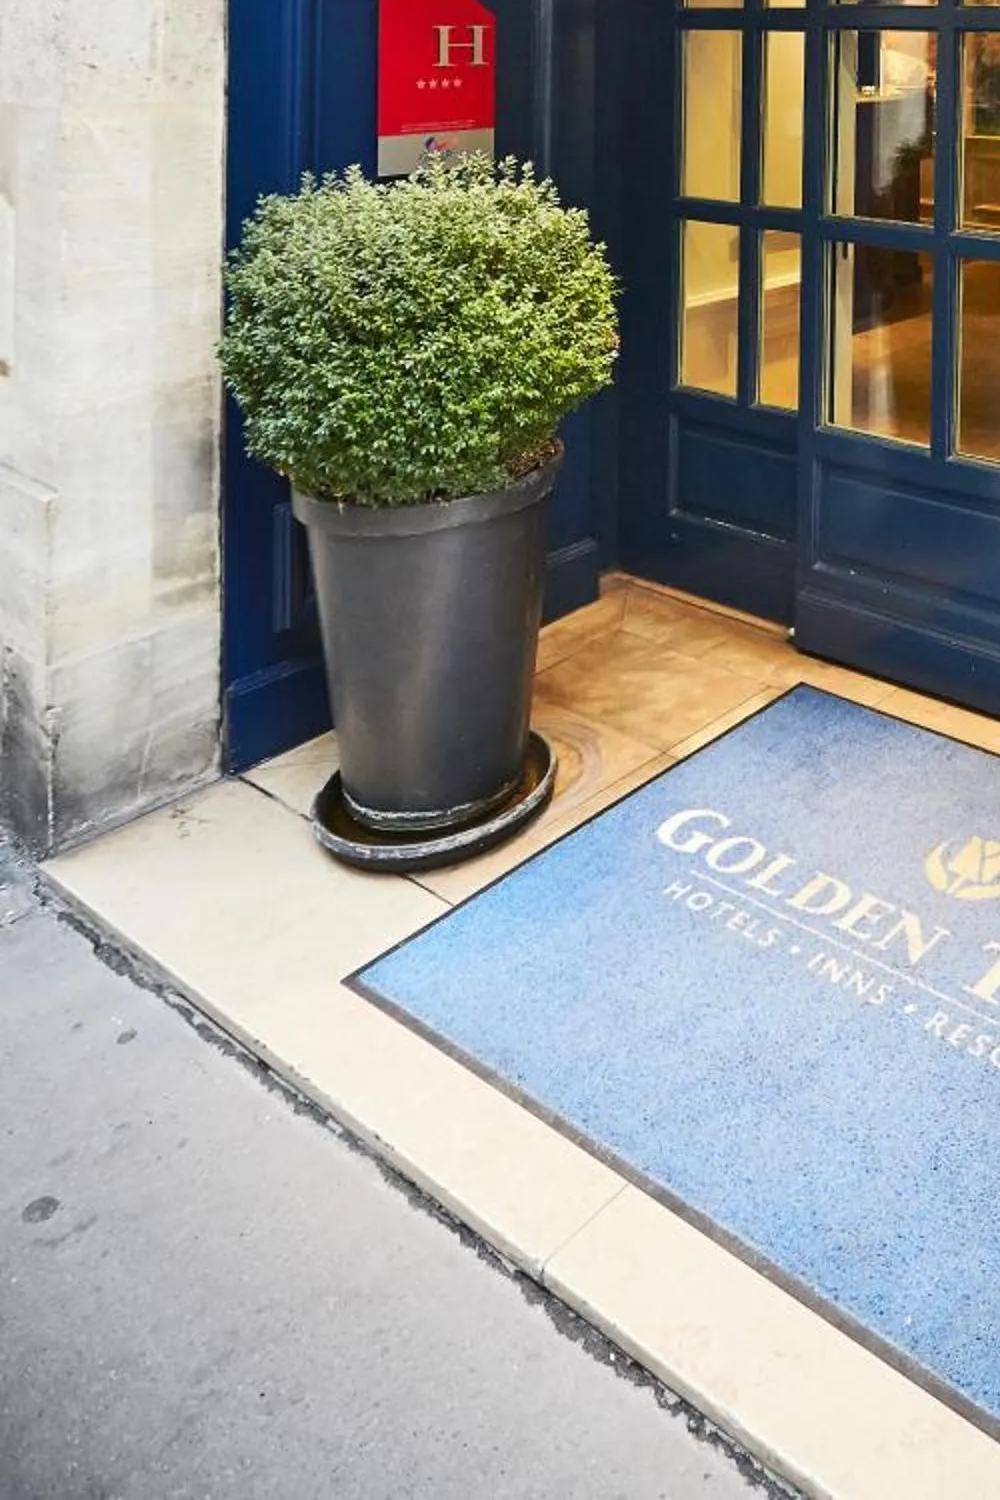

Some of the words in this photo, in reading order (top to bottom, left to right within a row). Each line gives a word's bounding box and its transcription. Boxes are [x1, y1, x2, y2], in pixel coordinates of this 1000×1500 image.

[432, 24, 489, 67] H
[655, 808, 951, 965] GOLDEN
[662, 880, 783, 948] HOTELS
[807, 952, 894, 1006] INNS
